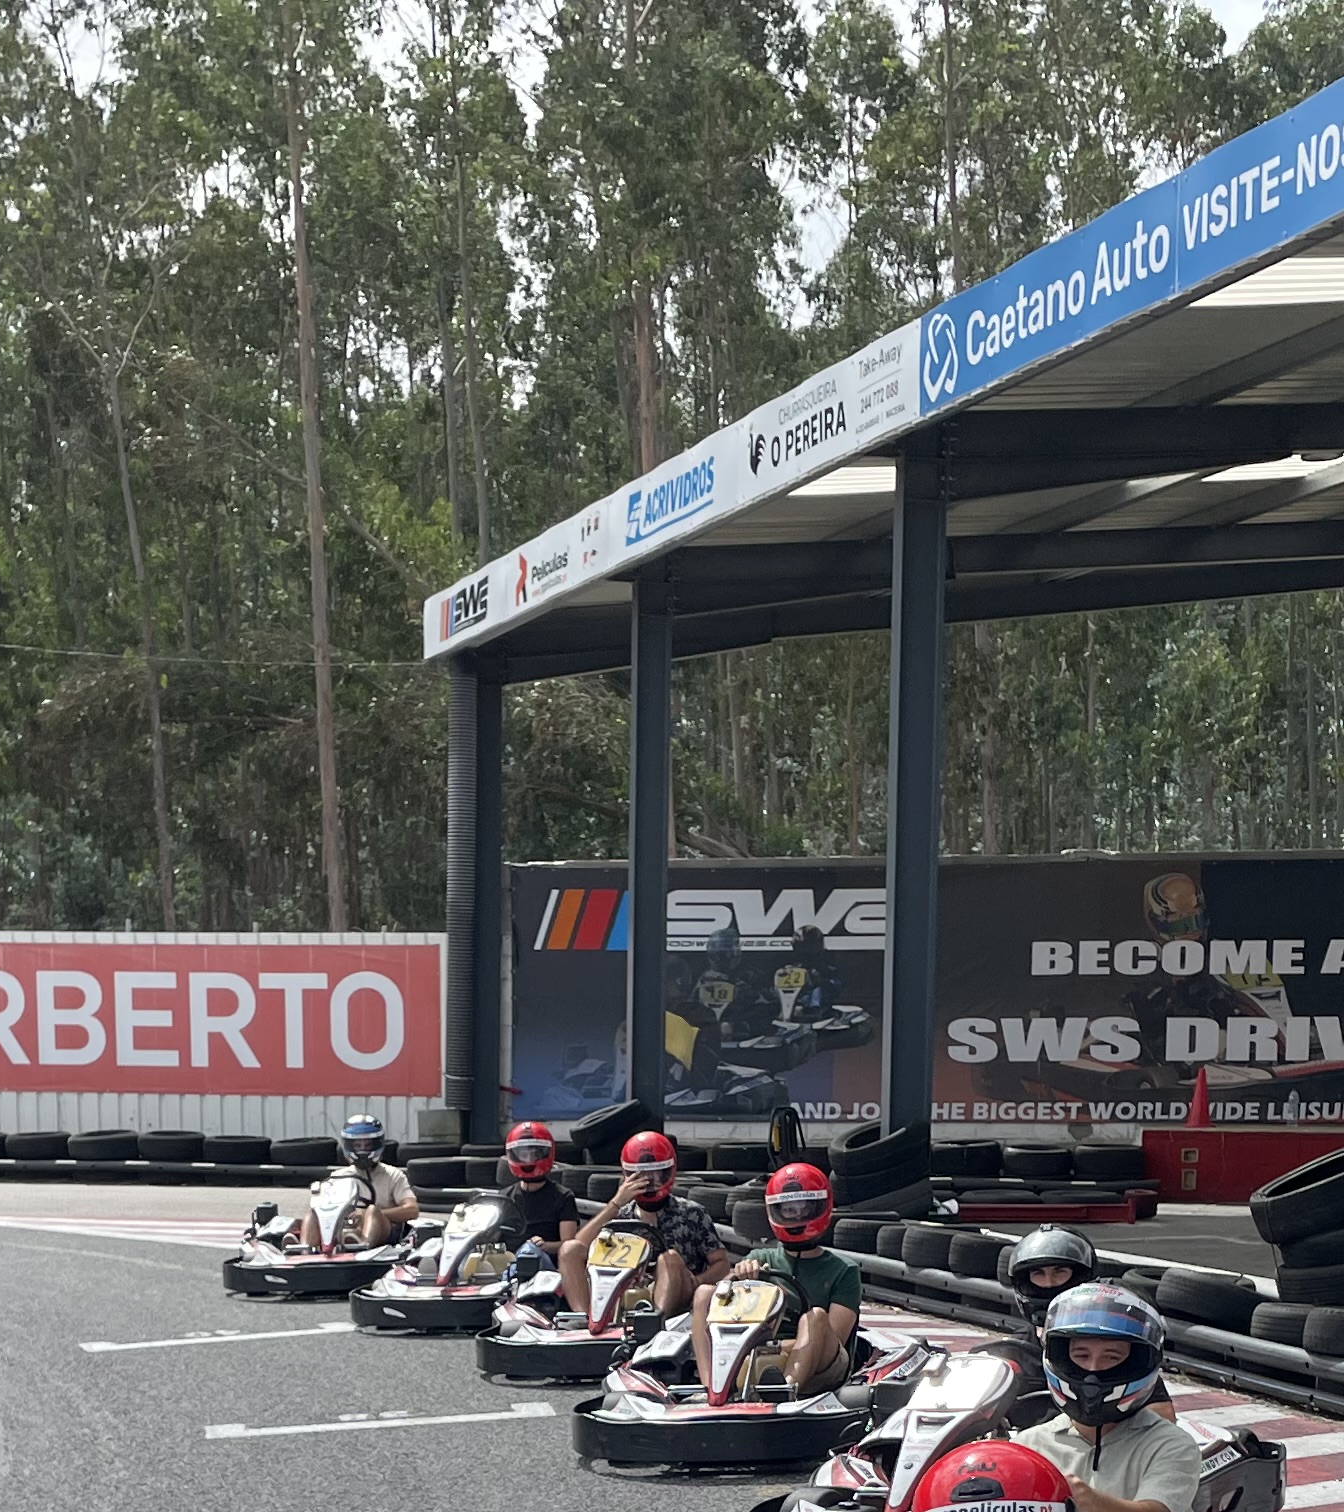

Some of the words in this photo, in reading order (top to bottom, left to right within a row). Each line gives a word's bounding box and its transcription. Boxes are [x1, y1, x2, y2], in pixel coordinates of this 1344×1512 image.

[966, 268, 1086, 366] Caetano
[1090, 219, 1171, 306] Auto
[771, 435, 781, 467] O
[785, 400, 846, 461] PEREIRA
[1030, 938, 1306, 976] BECOME
[947, 1015, 1141, 1063] SWS
[792, 1102, 842, 1119] AND
[847, 1102, 881, 1119] JO
[931, 1102, 965, 1120] HE
[972, 1102, 1081, 1120] BIGGEST
